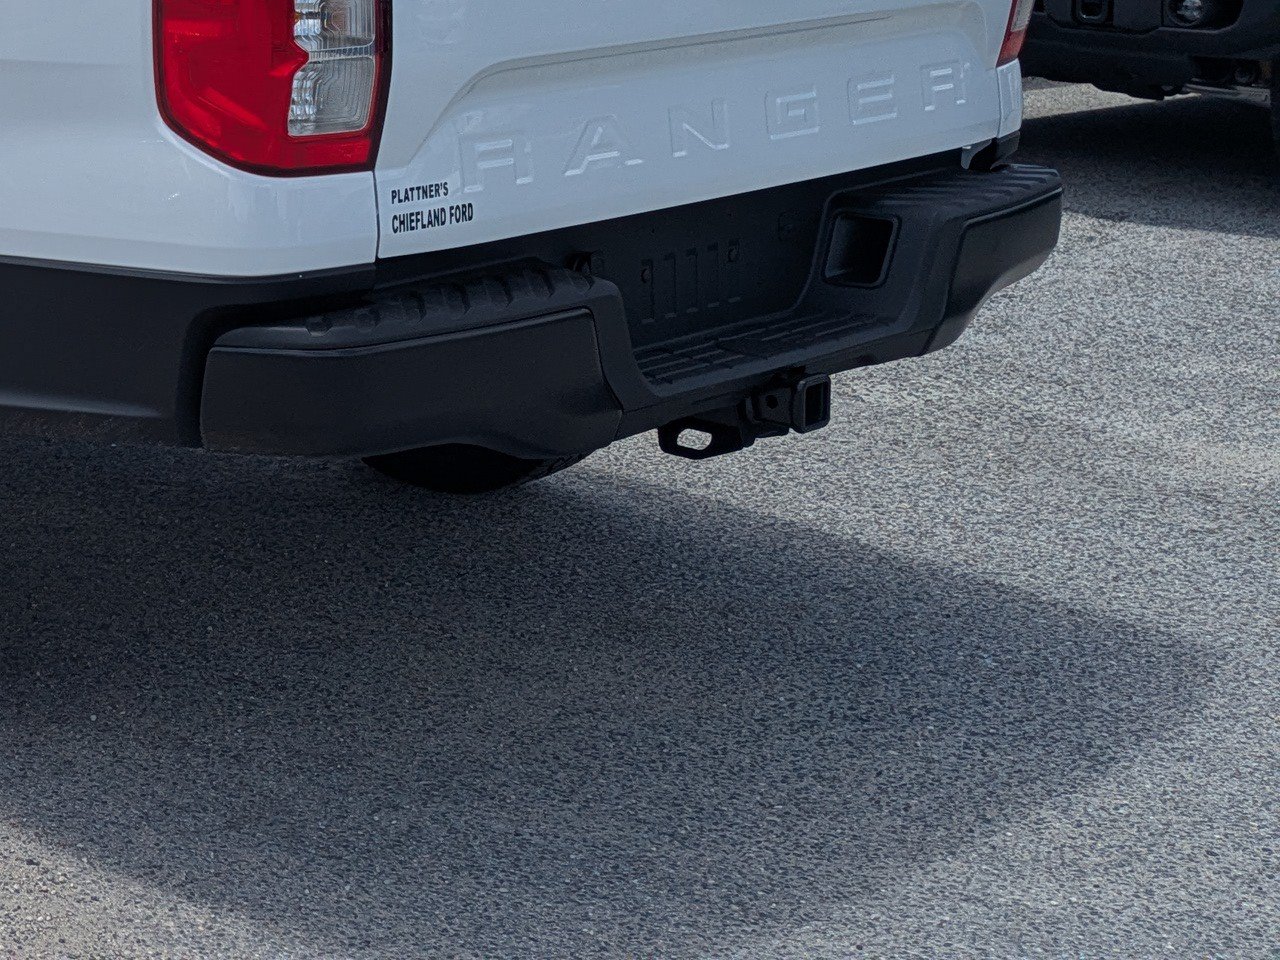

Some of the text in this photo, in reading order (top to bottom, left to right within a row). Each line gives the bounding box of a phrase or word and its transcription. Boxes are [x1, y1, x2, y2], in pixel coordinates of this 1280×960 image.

[457, 57, 969, 195] RANGER
[391, 181, 449, 204] PLATTNER'S
[391, 202, 474, 234] CHIEFLAND FORD
